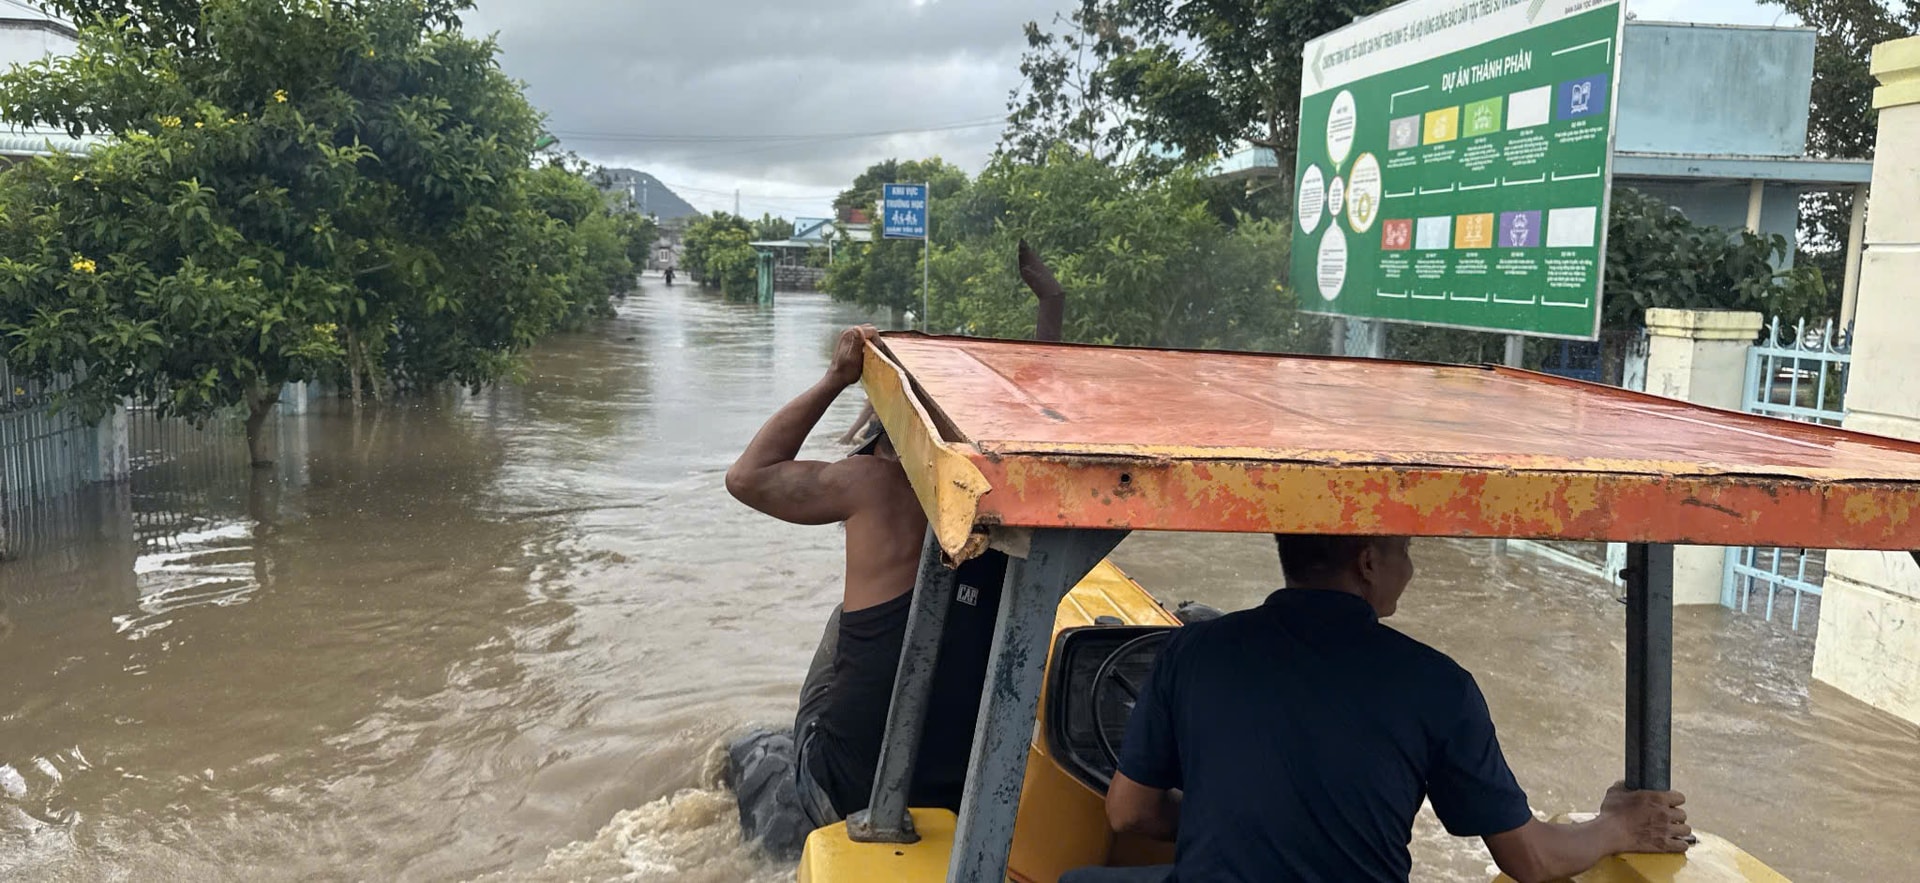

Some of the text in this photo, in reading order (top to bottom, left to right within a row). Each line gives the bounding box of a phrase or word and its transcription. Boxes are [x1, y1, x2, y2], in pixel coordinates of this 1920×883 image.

[1441, 48, 1532, 94] DỰ ÁN THÀNH PHẦN
